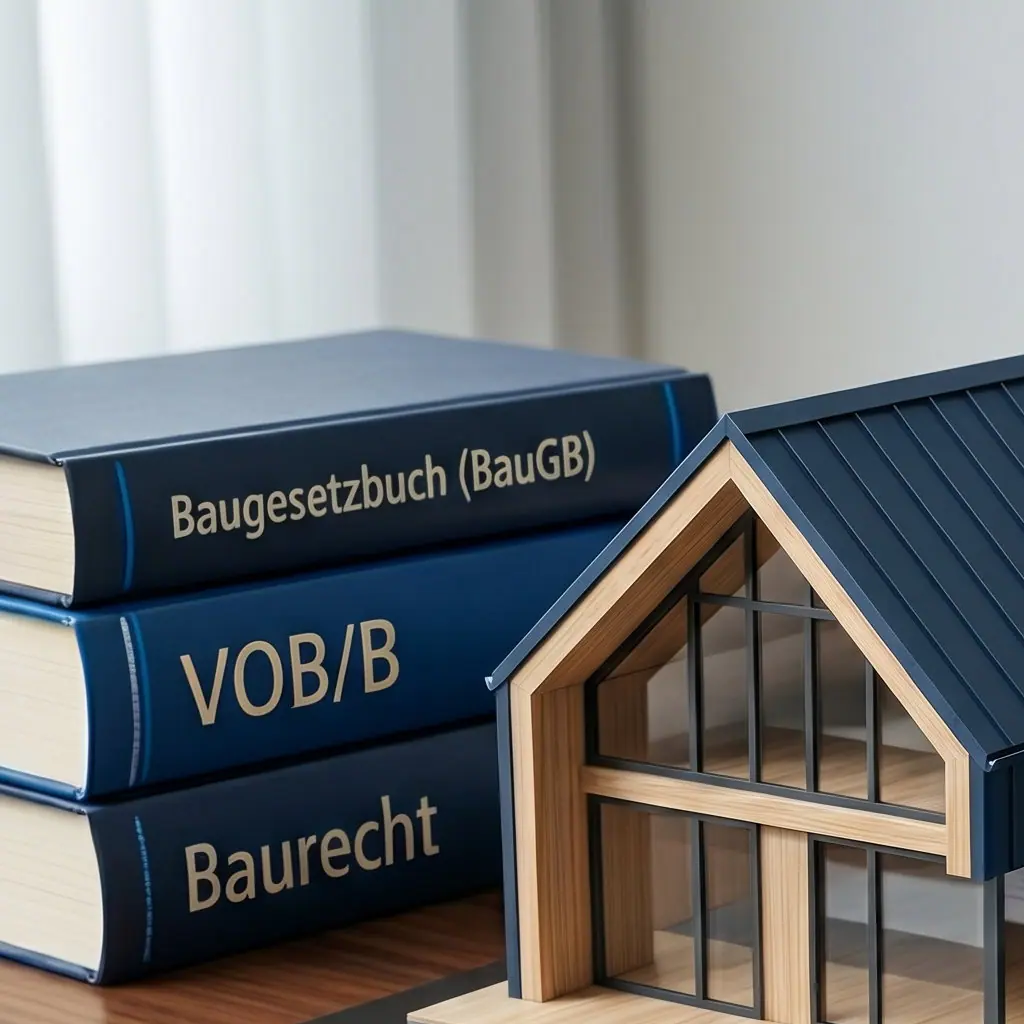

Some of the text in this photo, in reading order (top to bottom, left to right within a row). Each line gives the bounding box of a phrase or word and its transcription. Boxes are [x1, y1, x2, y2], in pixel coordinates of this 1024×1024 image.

[171, 430, 597, 540] Baugesetzbuch (BauGB)
[179, 618, 400, 727] VOB/B
[184, 795, 440, 914] Baurecht
